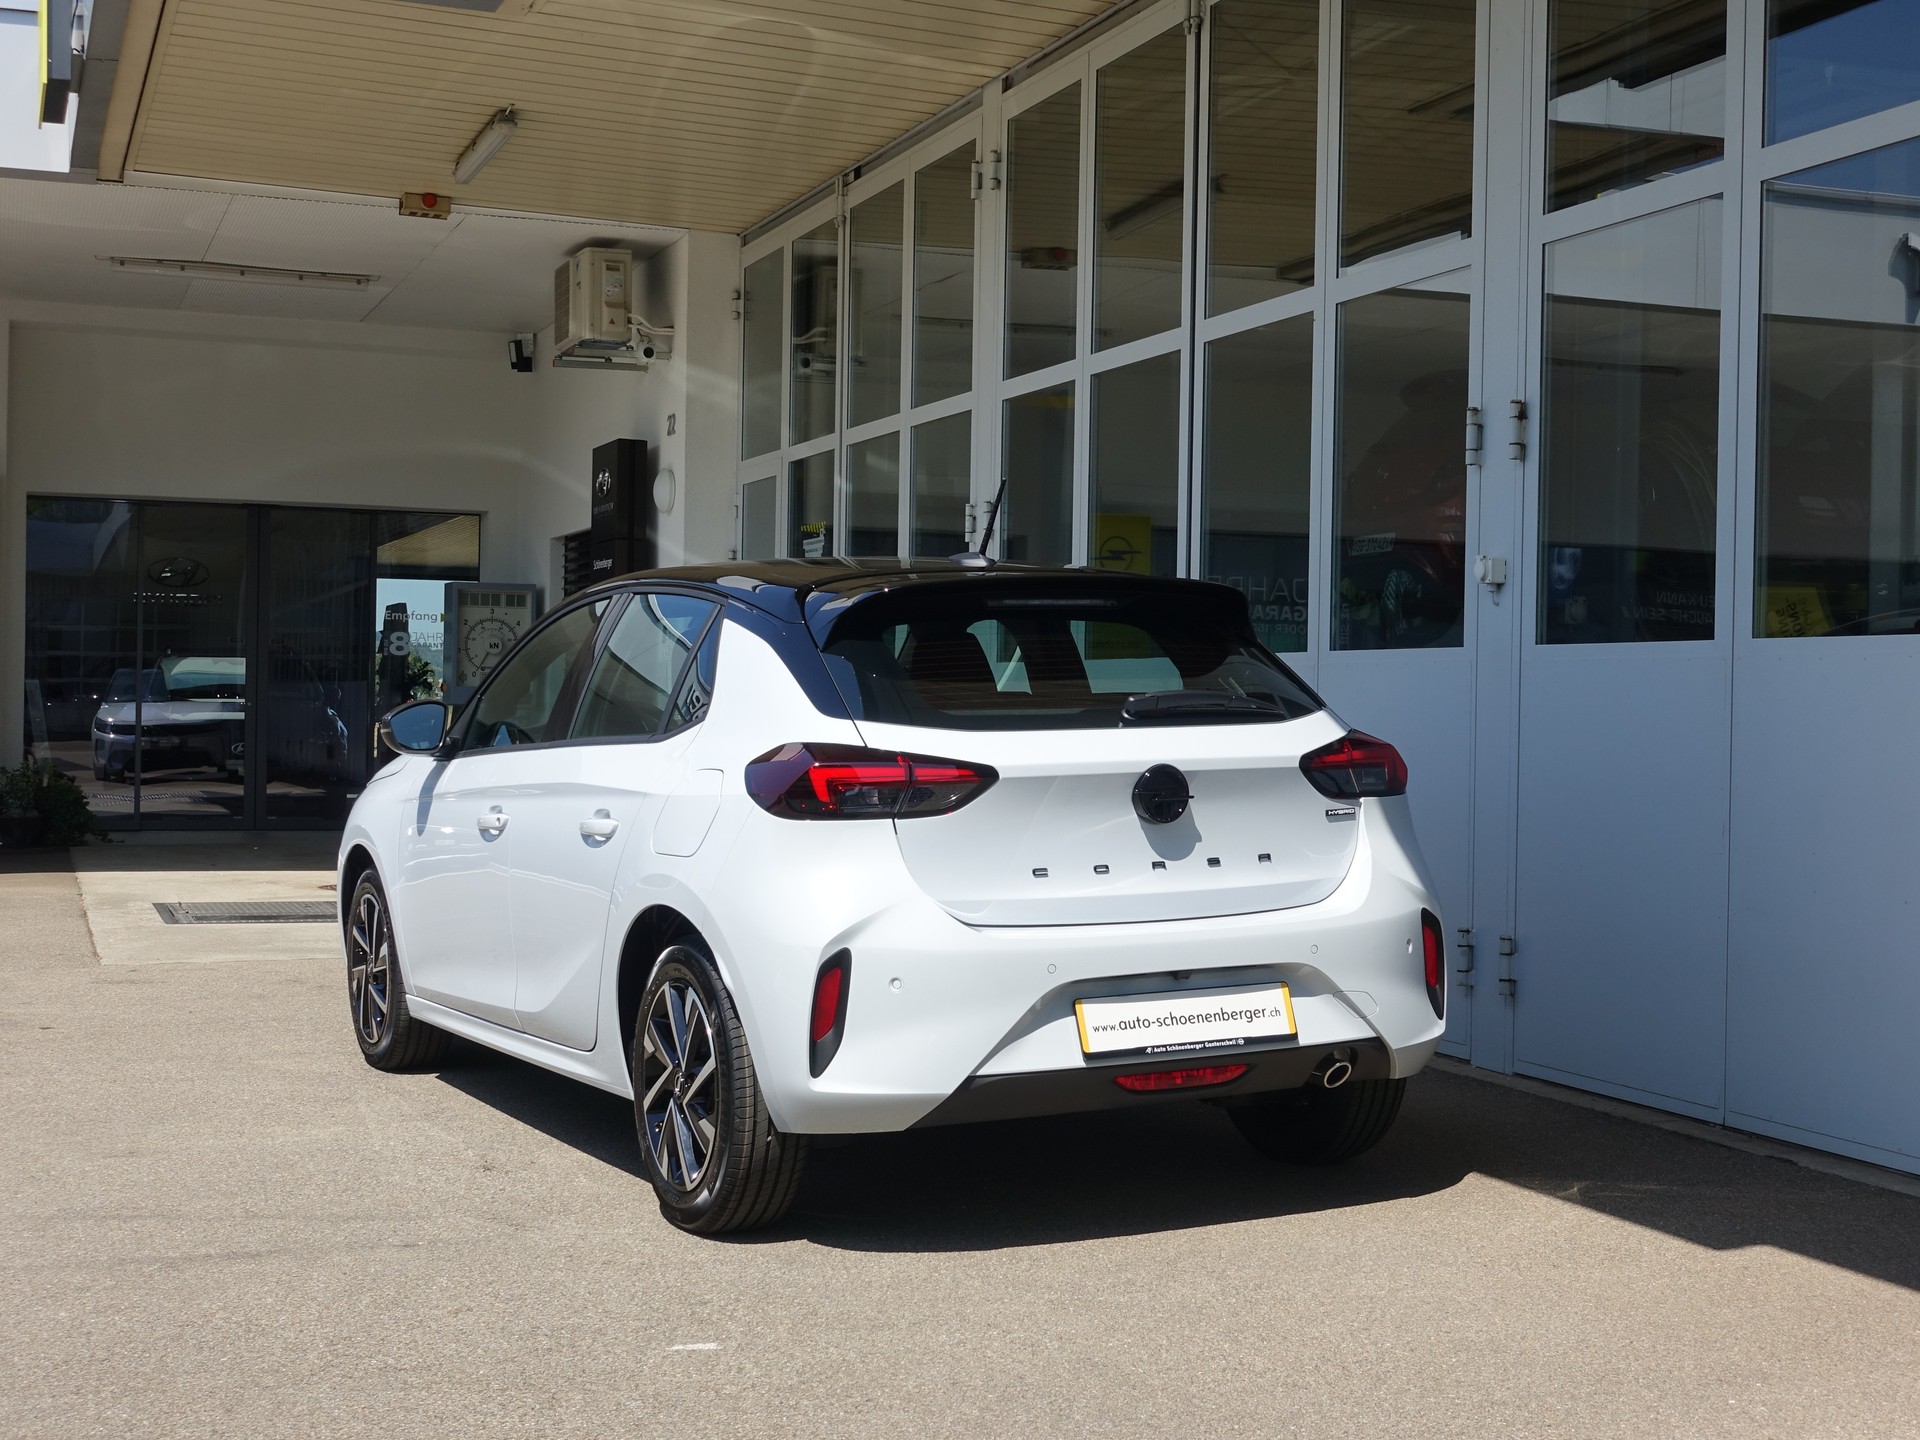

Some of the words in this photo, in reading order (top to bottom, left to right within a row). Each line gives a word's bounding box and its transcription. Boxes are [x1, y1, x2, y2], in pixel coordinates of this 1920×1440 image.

[667, 413, 677, 437] 22
[385, 610, 438, 623] Empfang
[389, 631, 410, 656] 8
[1328, 808, 1355, 816] HYBRID
[1032, 853, 1272, 878] CORSA
[1092, 1006, 1281, 1034] www.auto-schoenenberger.ch
